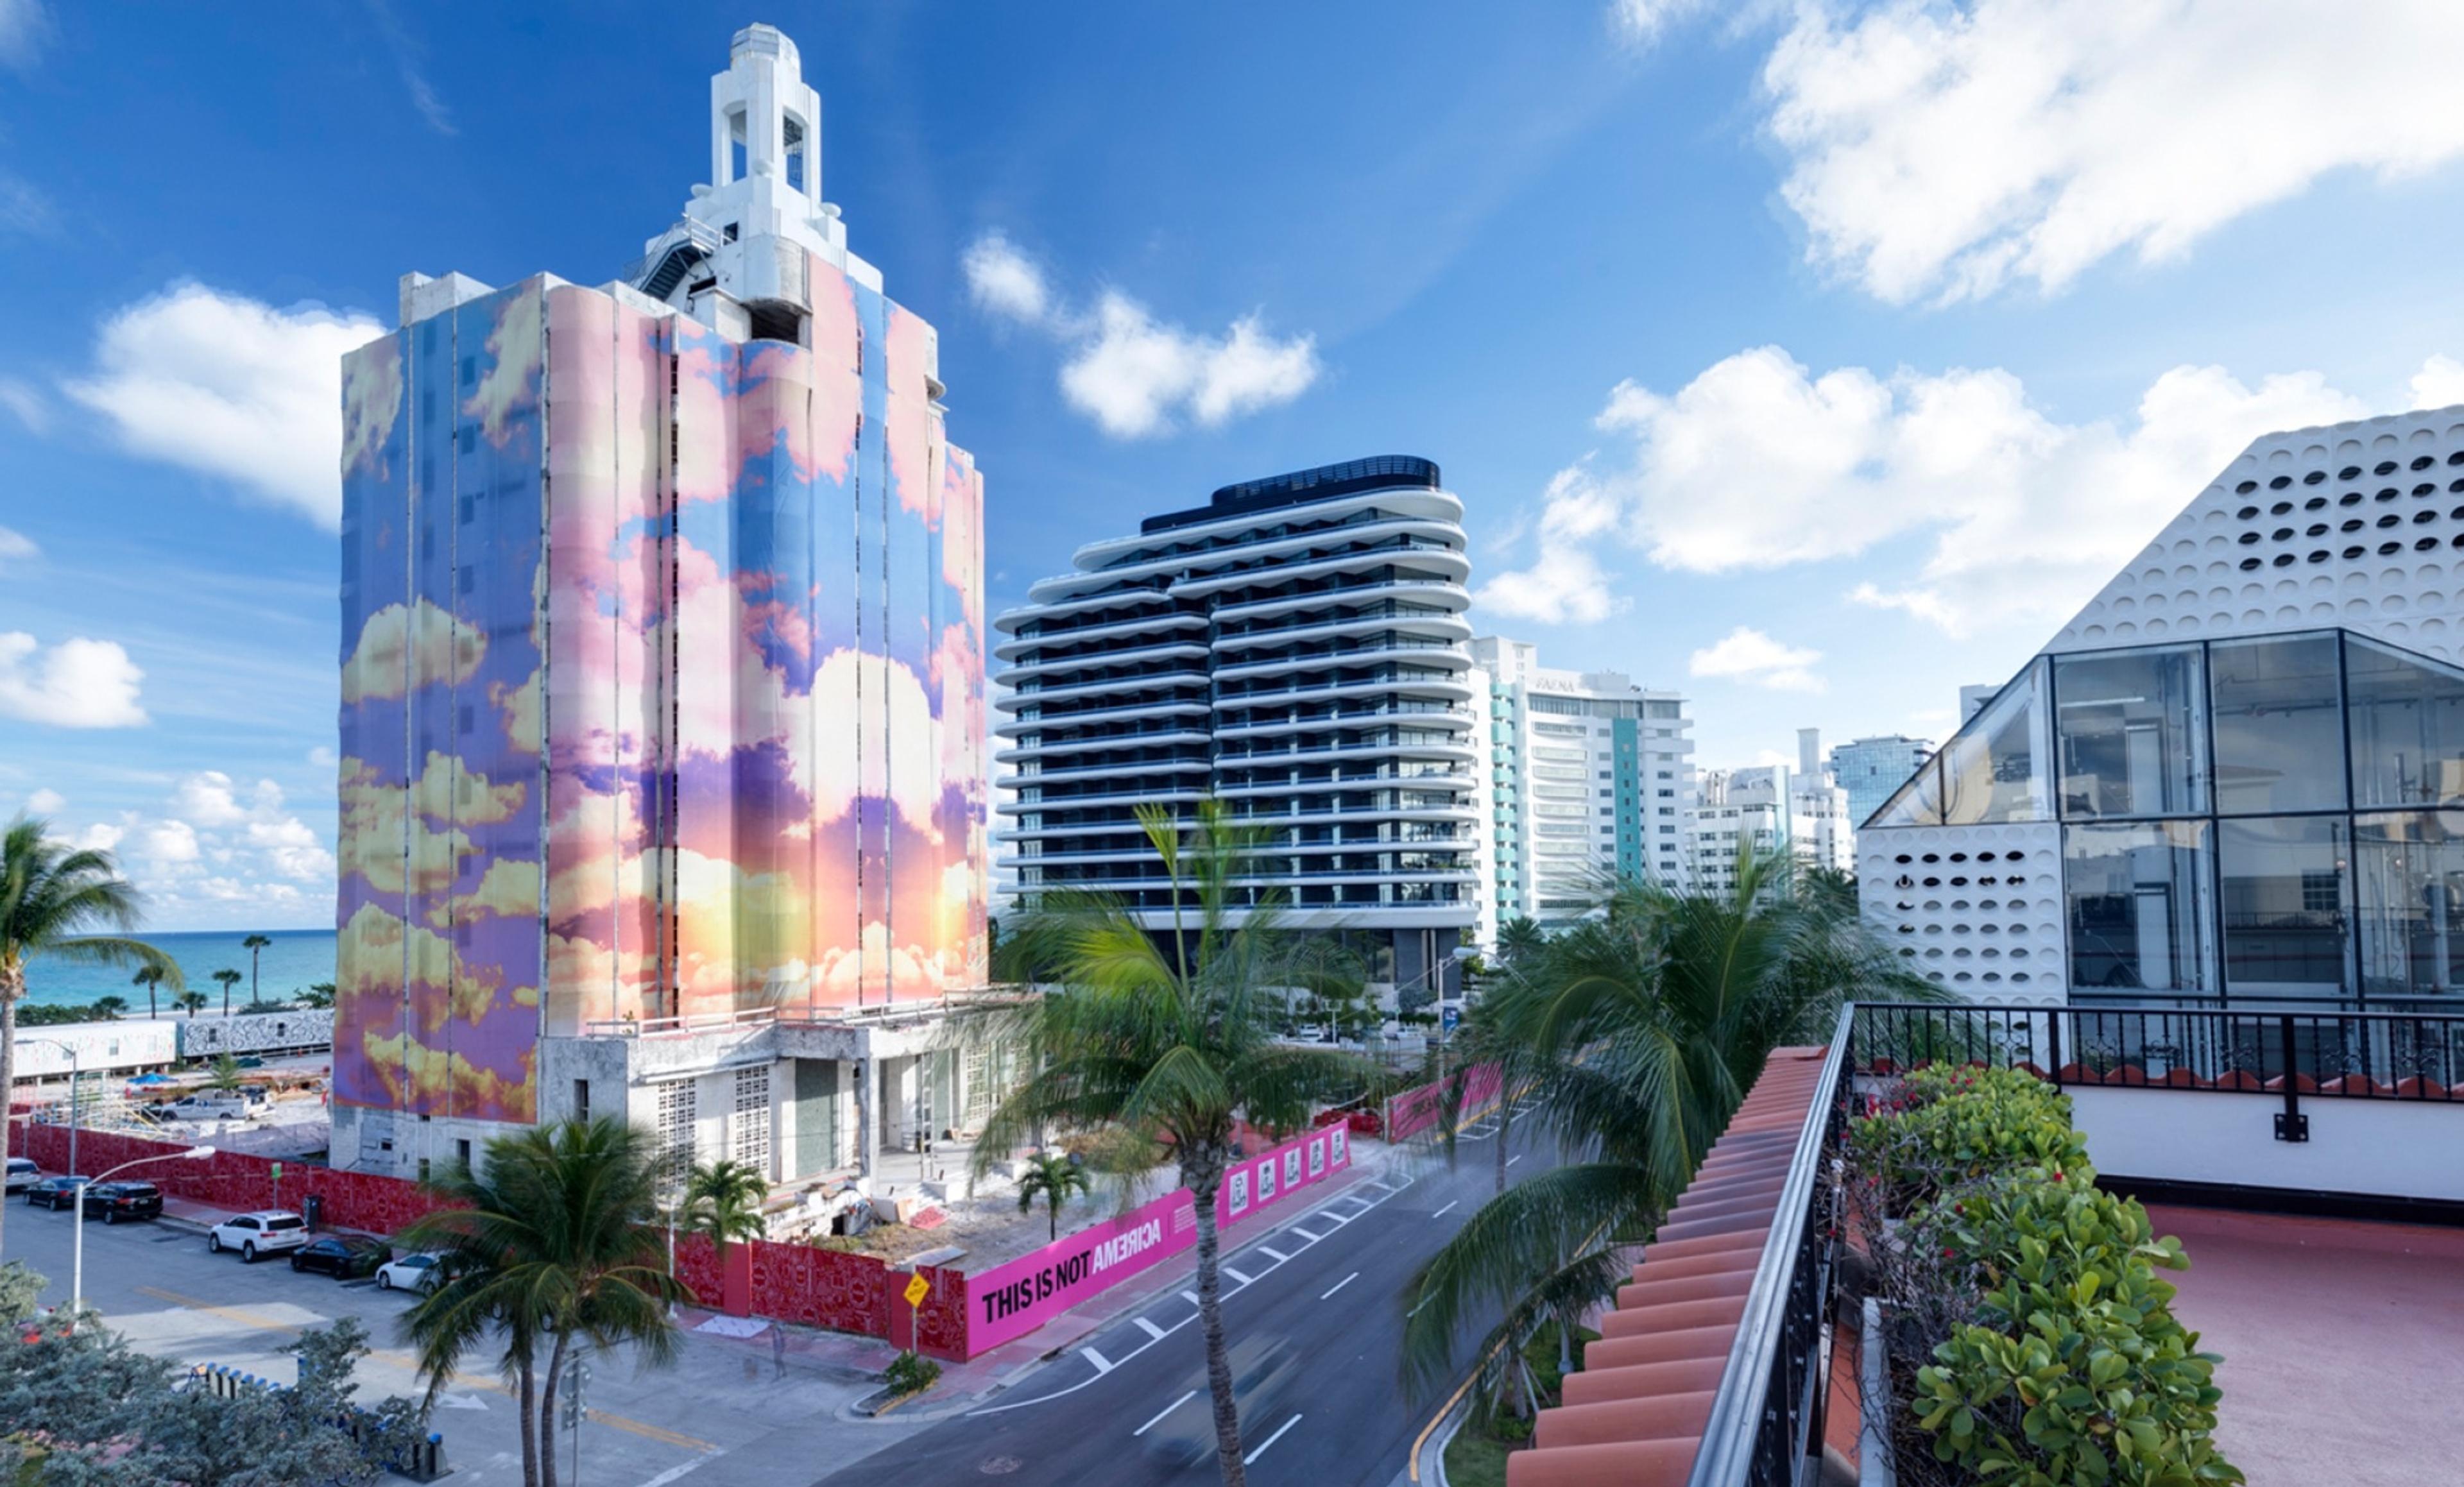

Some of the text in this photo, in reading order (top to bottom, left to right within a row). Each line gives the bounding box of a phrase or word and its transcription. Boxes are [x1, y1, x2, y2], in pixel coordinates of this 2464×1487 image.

[982, 1278, 1032, 1323] THIS
[1036, 1268, 1053, 1302] IS
[1056, 1250, 1091, 1291] NOT
